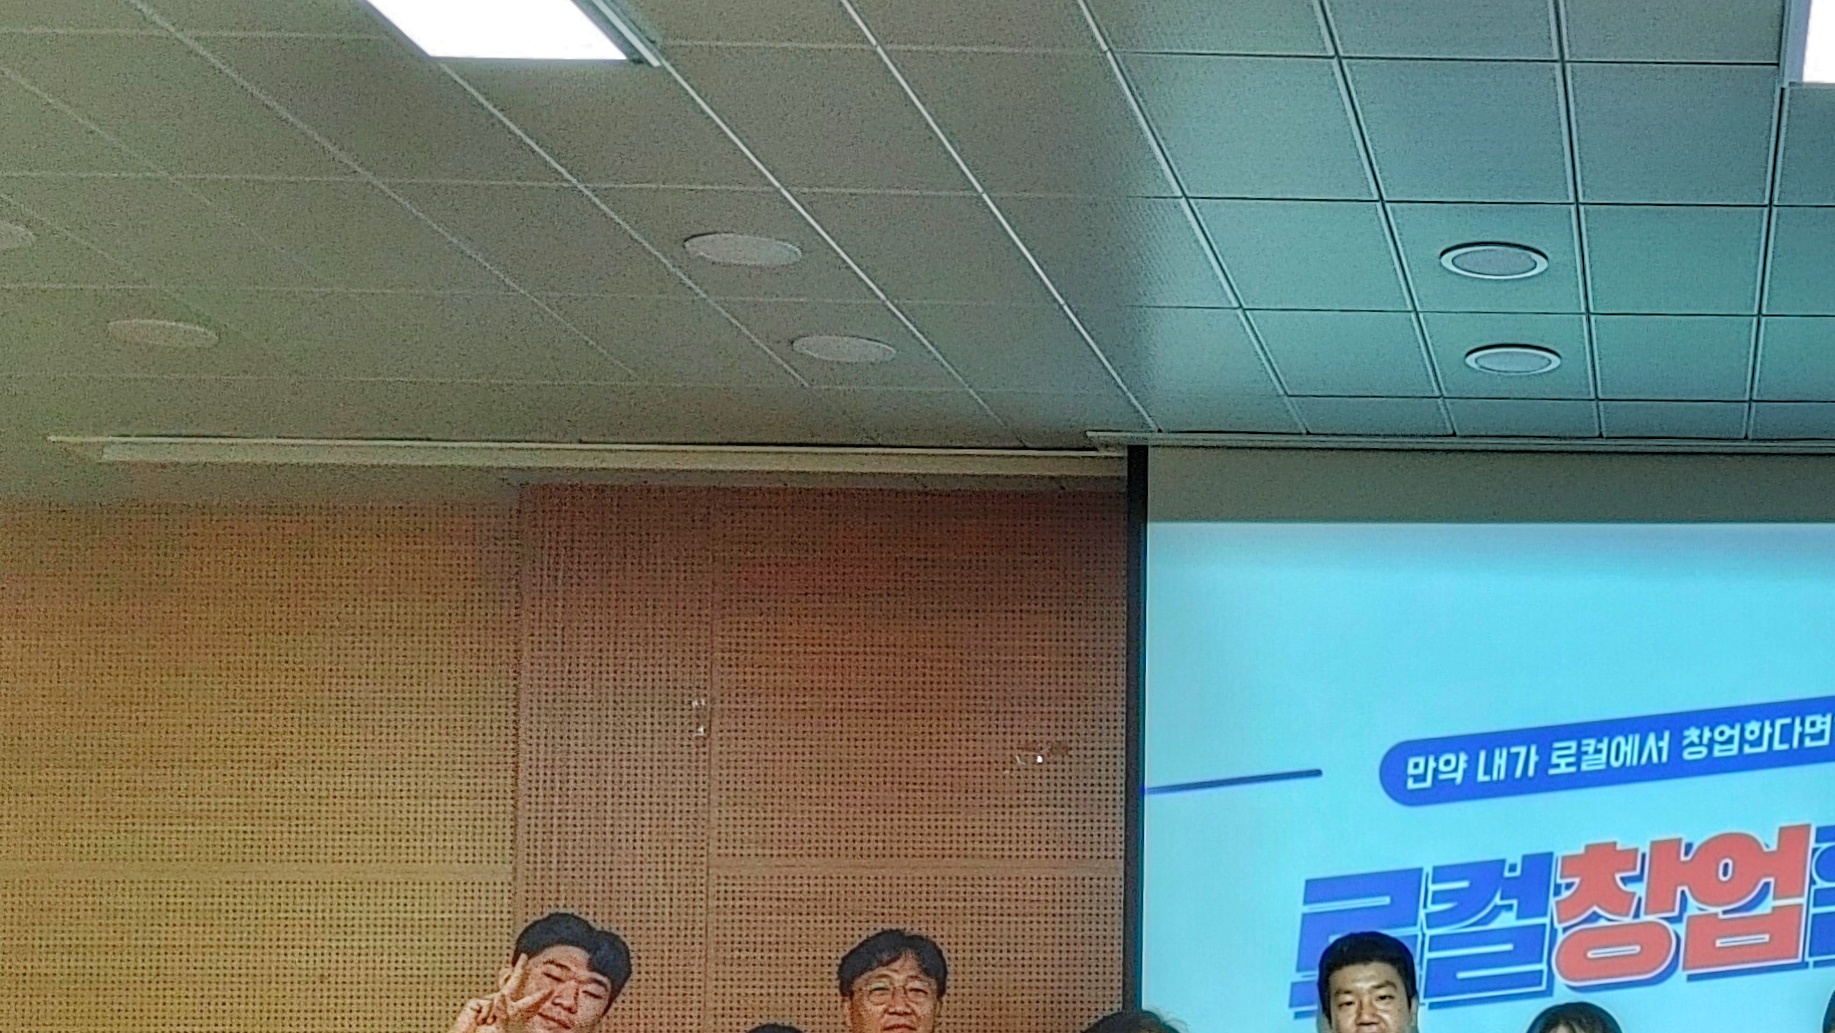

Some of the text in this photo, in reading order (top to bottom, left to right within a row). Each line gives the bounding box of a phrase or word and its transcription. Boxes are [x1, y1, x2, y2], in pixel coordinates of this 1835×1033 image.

[1406, 752, 1467, 790] 만약
[1476, 743, 1539, 782] 내가
[1547, 729, 1671, 777] 로컬에서
